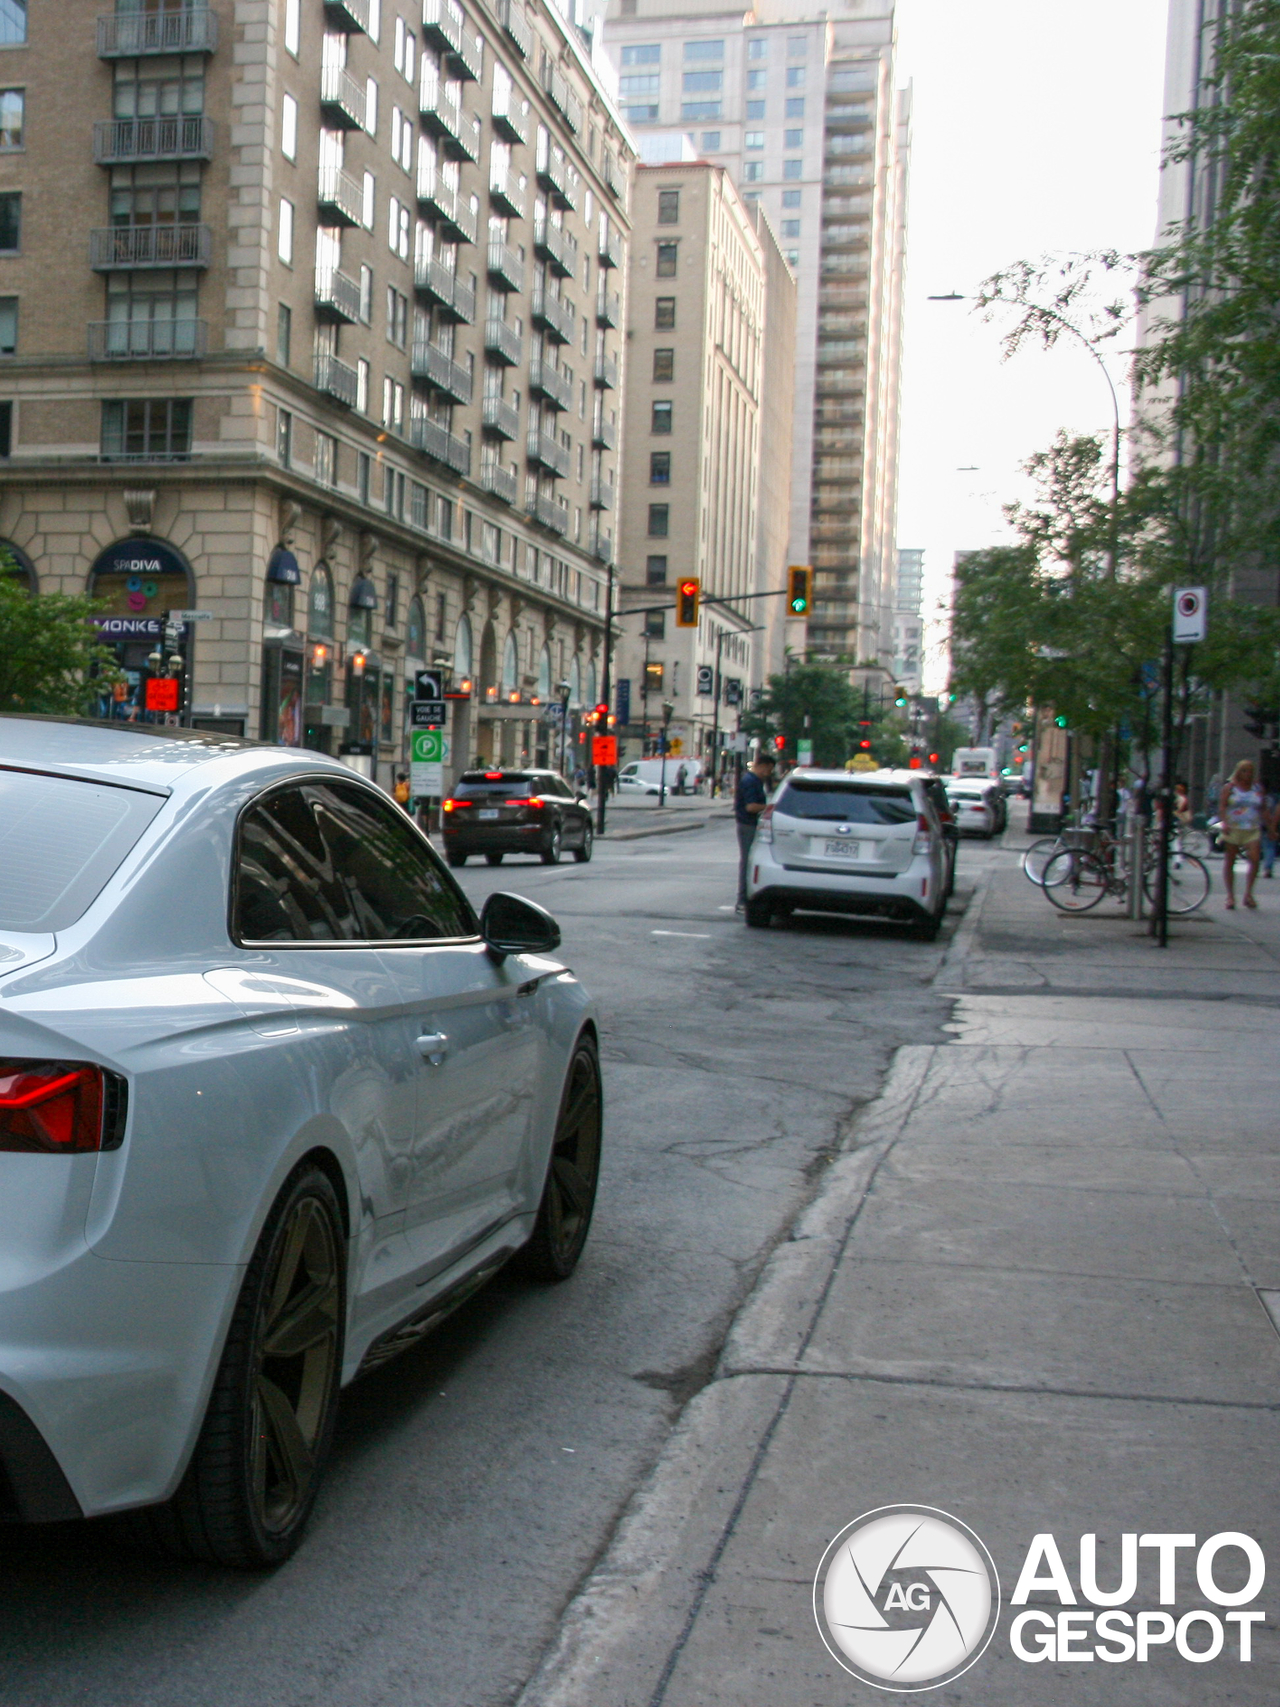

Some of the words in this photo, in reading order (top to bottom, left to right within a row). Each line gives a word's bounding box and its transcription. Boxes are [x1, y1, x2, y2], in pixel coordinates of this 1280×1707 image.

[94, 620, 186, 632] MONKES
[415, 706, 431, 714] VOIE
[415, 714, 441, 722] GAUCHE
